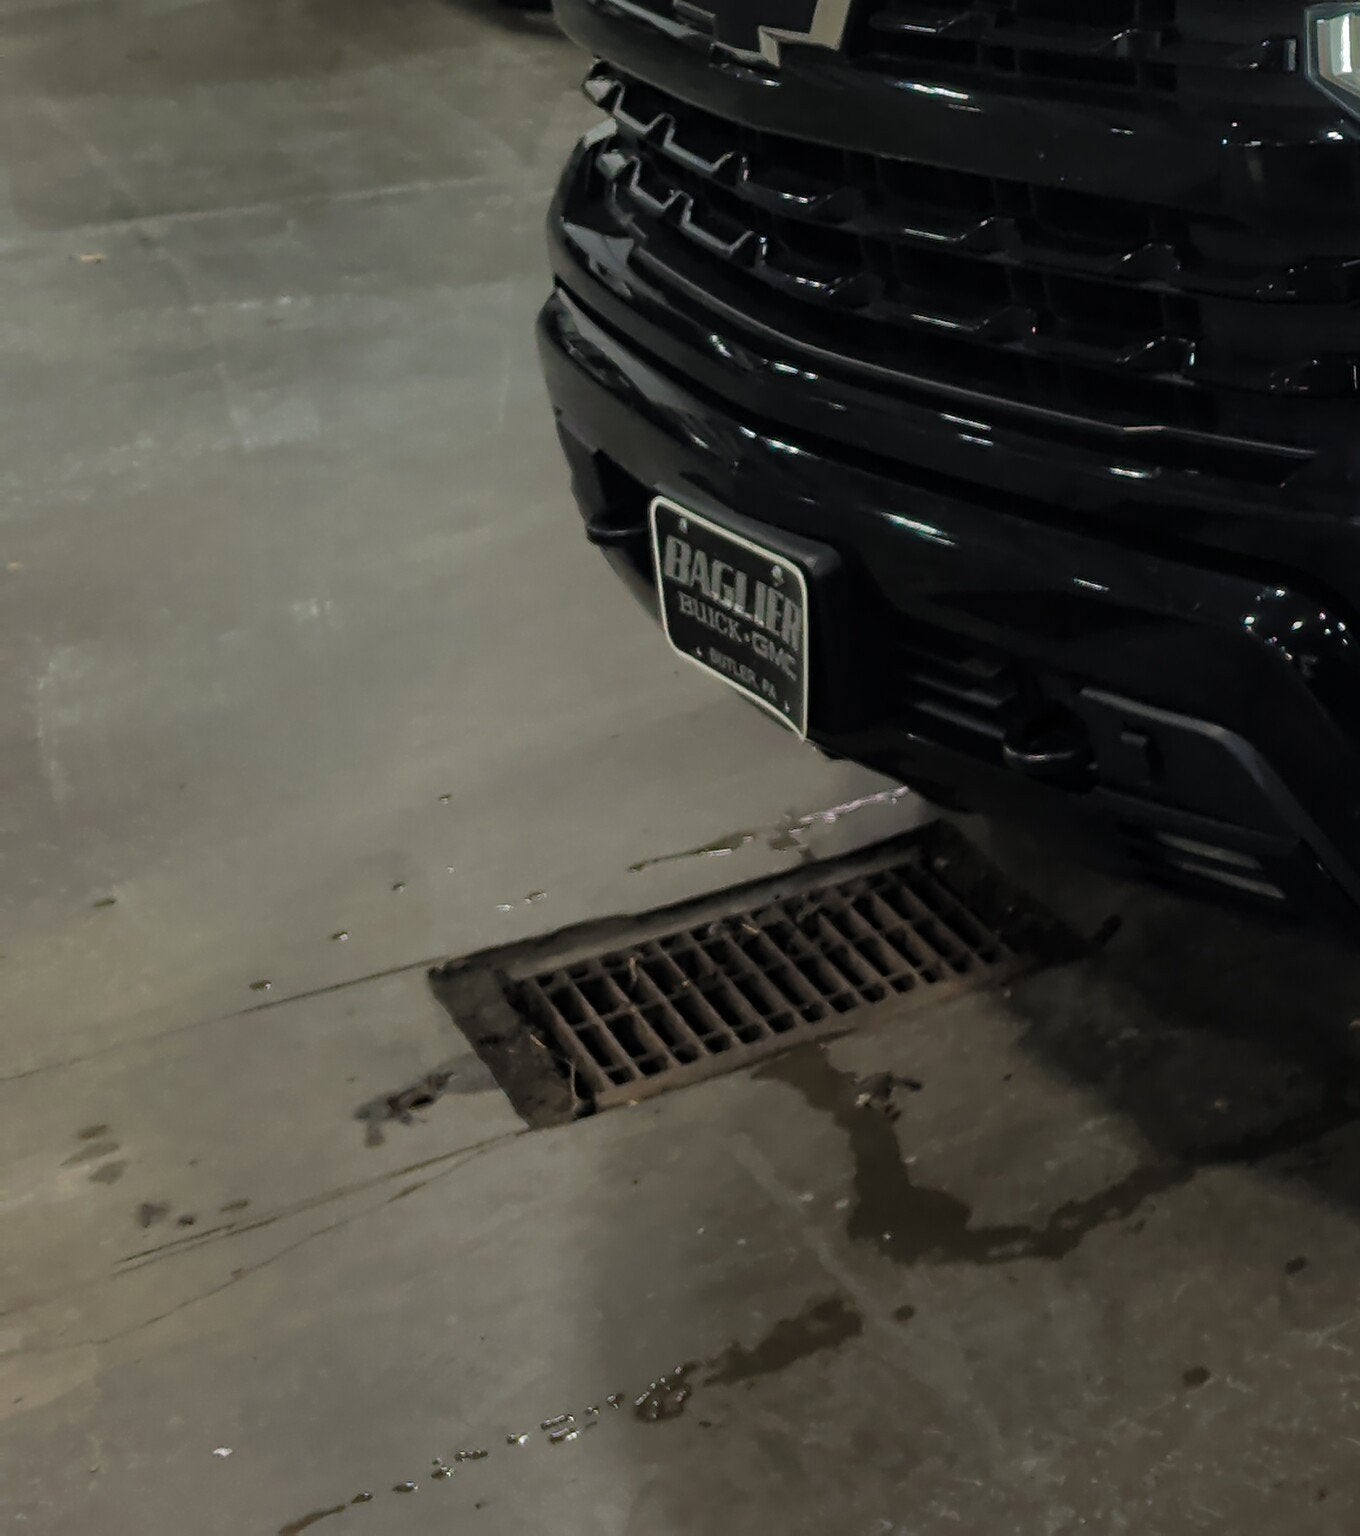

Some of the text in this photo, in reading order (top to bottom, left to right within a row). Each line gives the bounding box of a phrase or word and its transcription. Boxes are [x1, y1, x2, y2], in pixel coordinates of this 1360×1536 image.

[663, 534, 800, 652] BAGLIER
[678, 590, 798, 682] BUICK GMC
